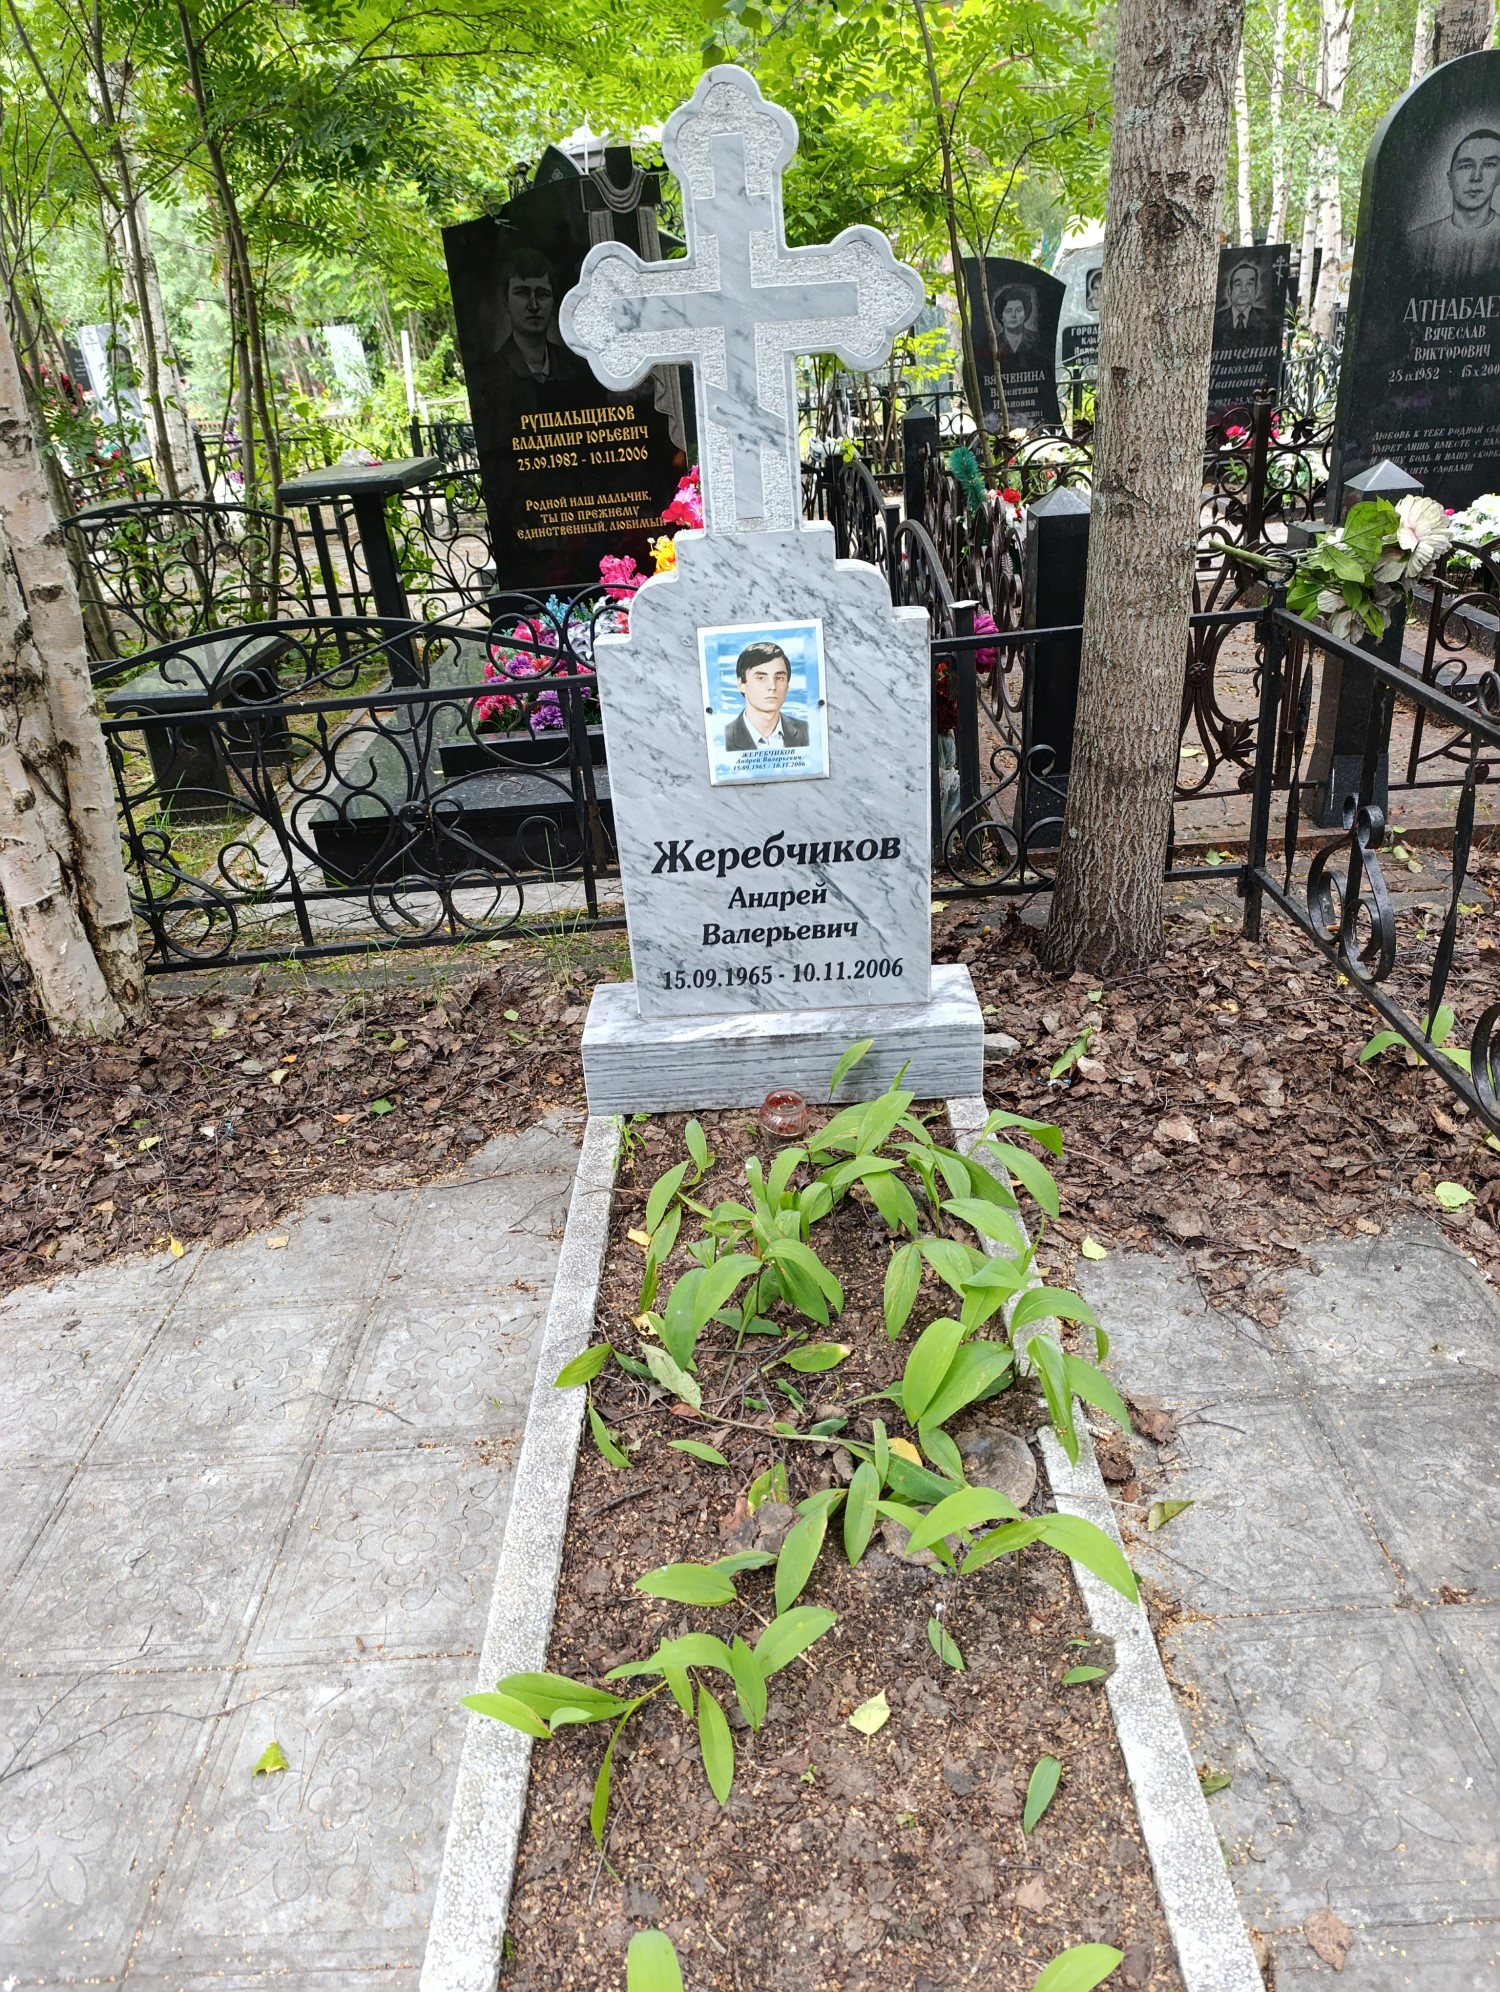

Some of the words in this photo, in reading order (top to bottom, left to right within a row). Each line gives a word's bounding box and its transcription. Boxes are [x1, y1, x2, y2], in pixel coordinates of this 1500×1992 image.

[1402, 295, 1500, 323] АТНАБАЕ
[1423, 324, 1486, 341] ВЯЧЕСЛАВ
[1211, 346, 1278, 361] ятченин
[1414, 344, 1491, 361] ВИКТОРОВИЧ
[984, 370, 1045, 386] ВЯЧЕНИНА
[520, 405, 635, 433] РУШАЛЬЩИКОВ
[512, 431, 583, 450] ВЛАДИМИР
[586, 425, 649, 444] ЮРЬЕВИЧ
[1413, 430, 1421, 438] К
[1423, 428, 1445, 437] ТЕБЕ
[517, 452, 578, 471] 25.09.1982
[590, 445, 648, 464] 10.11.2006
[570, 495, 595, 507] НАШ
[597, 490, 652, 504] МАЛЬЧИК,
[540, 512, 558, 524] ТЫ
[560, 511, 574, 522] ПО
[577, 505, 640, 520] ПРЕЖНЕМУ
[517, 521, 608, 540] ЕДИНСТВЕННЫЙ,
[651, 830, 901, 878] Жеребчиков
[728, 882, 827, 911] Андрей
[702, 921, 858, 947] Валерьевич
[663, 965, 772, 990] 15.09.1965
[792, 958, 904, 982] 10.11.2006
